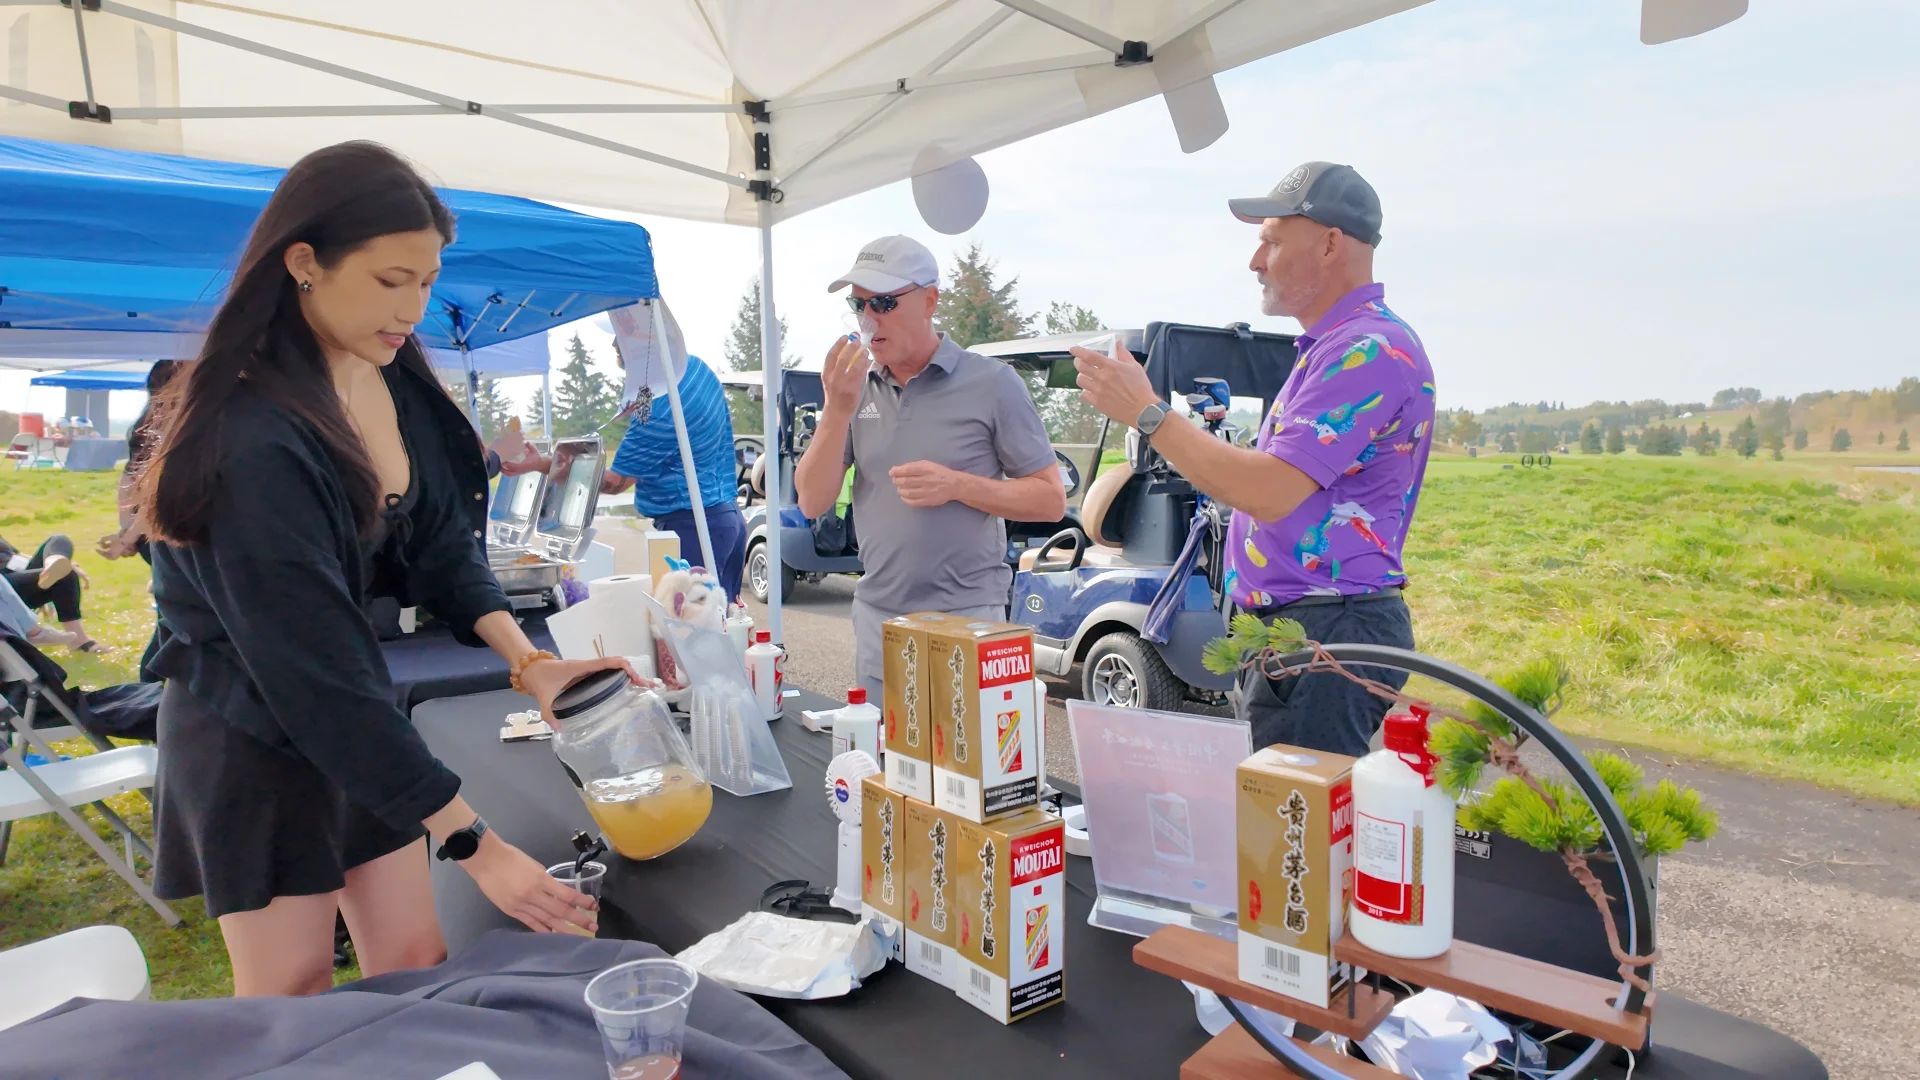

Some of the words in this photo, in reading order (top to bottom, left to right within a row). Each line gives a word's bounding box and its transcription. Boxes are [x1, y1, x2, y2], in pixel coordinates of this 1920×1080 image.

[1031, 598, 1040, 608] 13
[987, 646, 1023, 657] KWEICHOW
[981, 654, 1031, 681] MOUTAI
[1019, 838, 1055, 853] KWEICHOW
[1013, 845, 1061, 878] MOUTAI
